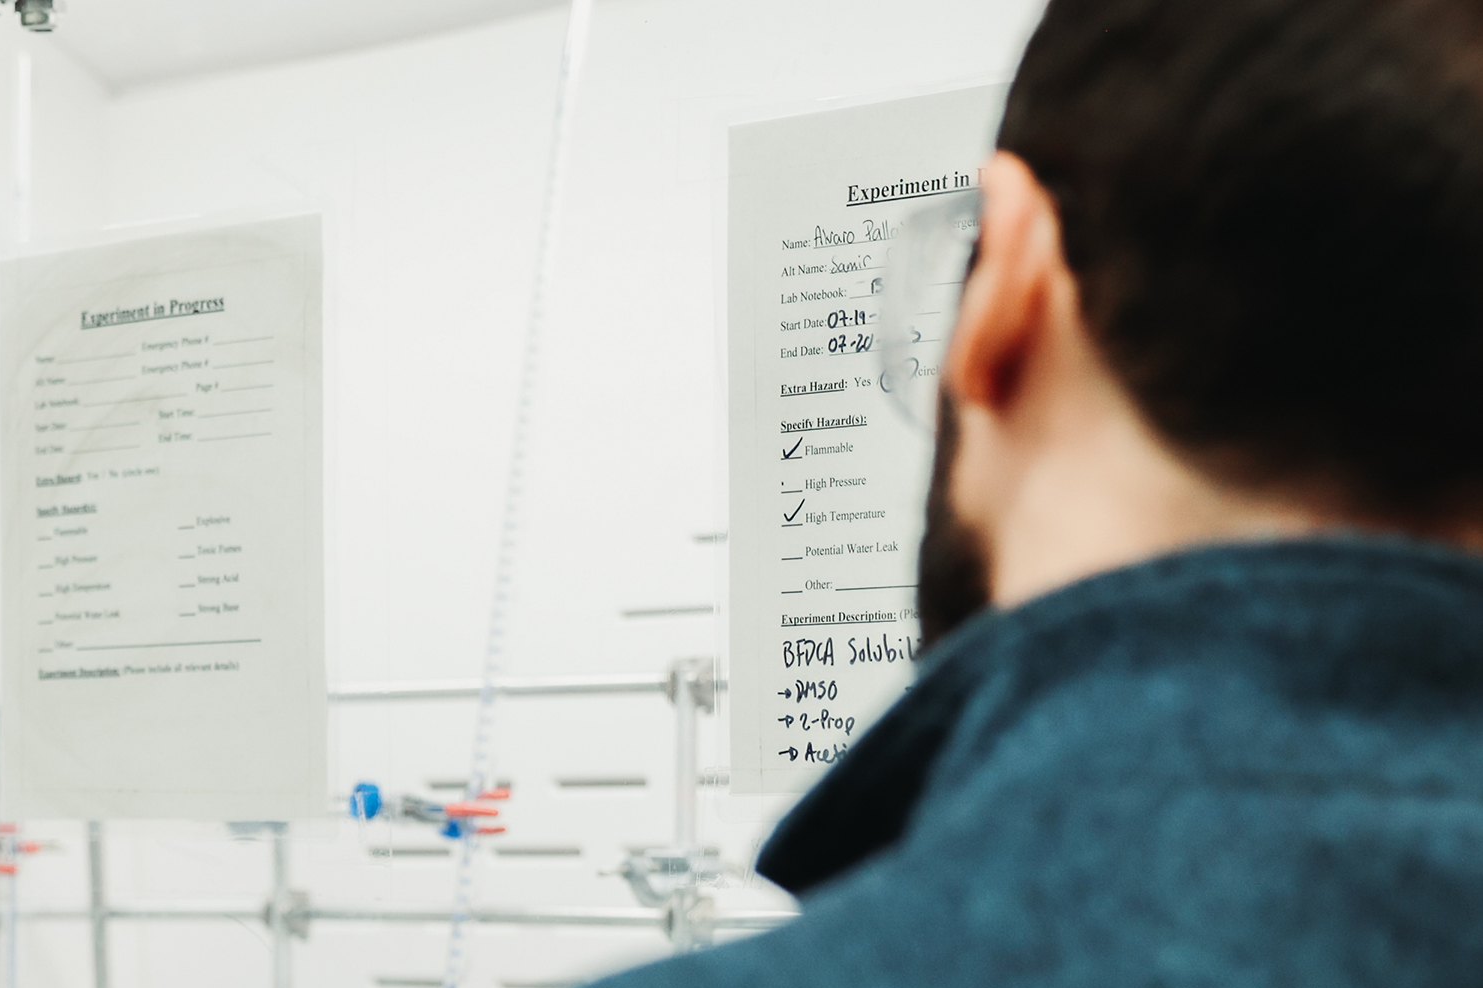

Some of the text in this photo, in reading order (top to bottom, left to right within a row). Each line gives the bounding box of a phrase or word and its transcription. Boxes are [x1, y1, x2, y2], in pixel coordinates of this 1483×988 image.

[846, 174, 949, 205] Experiment
[953, 170, 970, 188] in
[781, 239, 811, 251] Name:
[781, 264, 827, 277] Alt Name:
[830, 254, 873, 274] Samir
[780, 287, 847, 304] Lab Notebook:
[81, 297, 225, 328] Experiment in Progress
[780, 318, 827, 332] Start Date:
[780, 344, 824, 359] End Date:
[780, 383, 808, 397] Extra
[809, 378, 849, 393] Hazard:
[854, 376, 872, 388] Yes
[780, 414, 868, 433] Specify Hazard(s):
[804, 441, 854, 456] Flammable
[805, 476, 867, 492] High Pressure
[805, 509, 886, 525] High Temperature
[805, 541, 899, 557] Potential Water Leak
[804, 579, 833, 591] Other:
[780, 613, 835, 627] Experiment
[838, 611, 897, 624] Description:
[795, 679, 838, 703] DMSO
